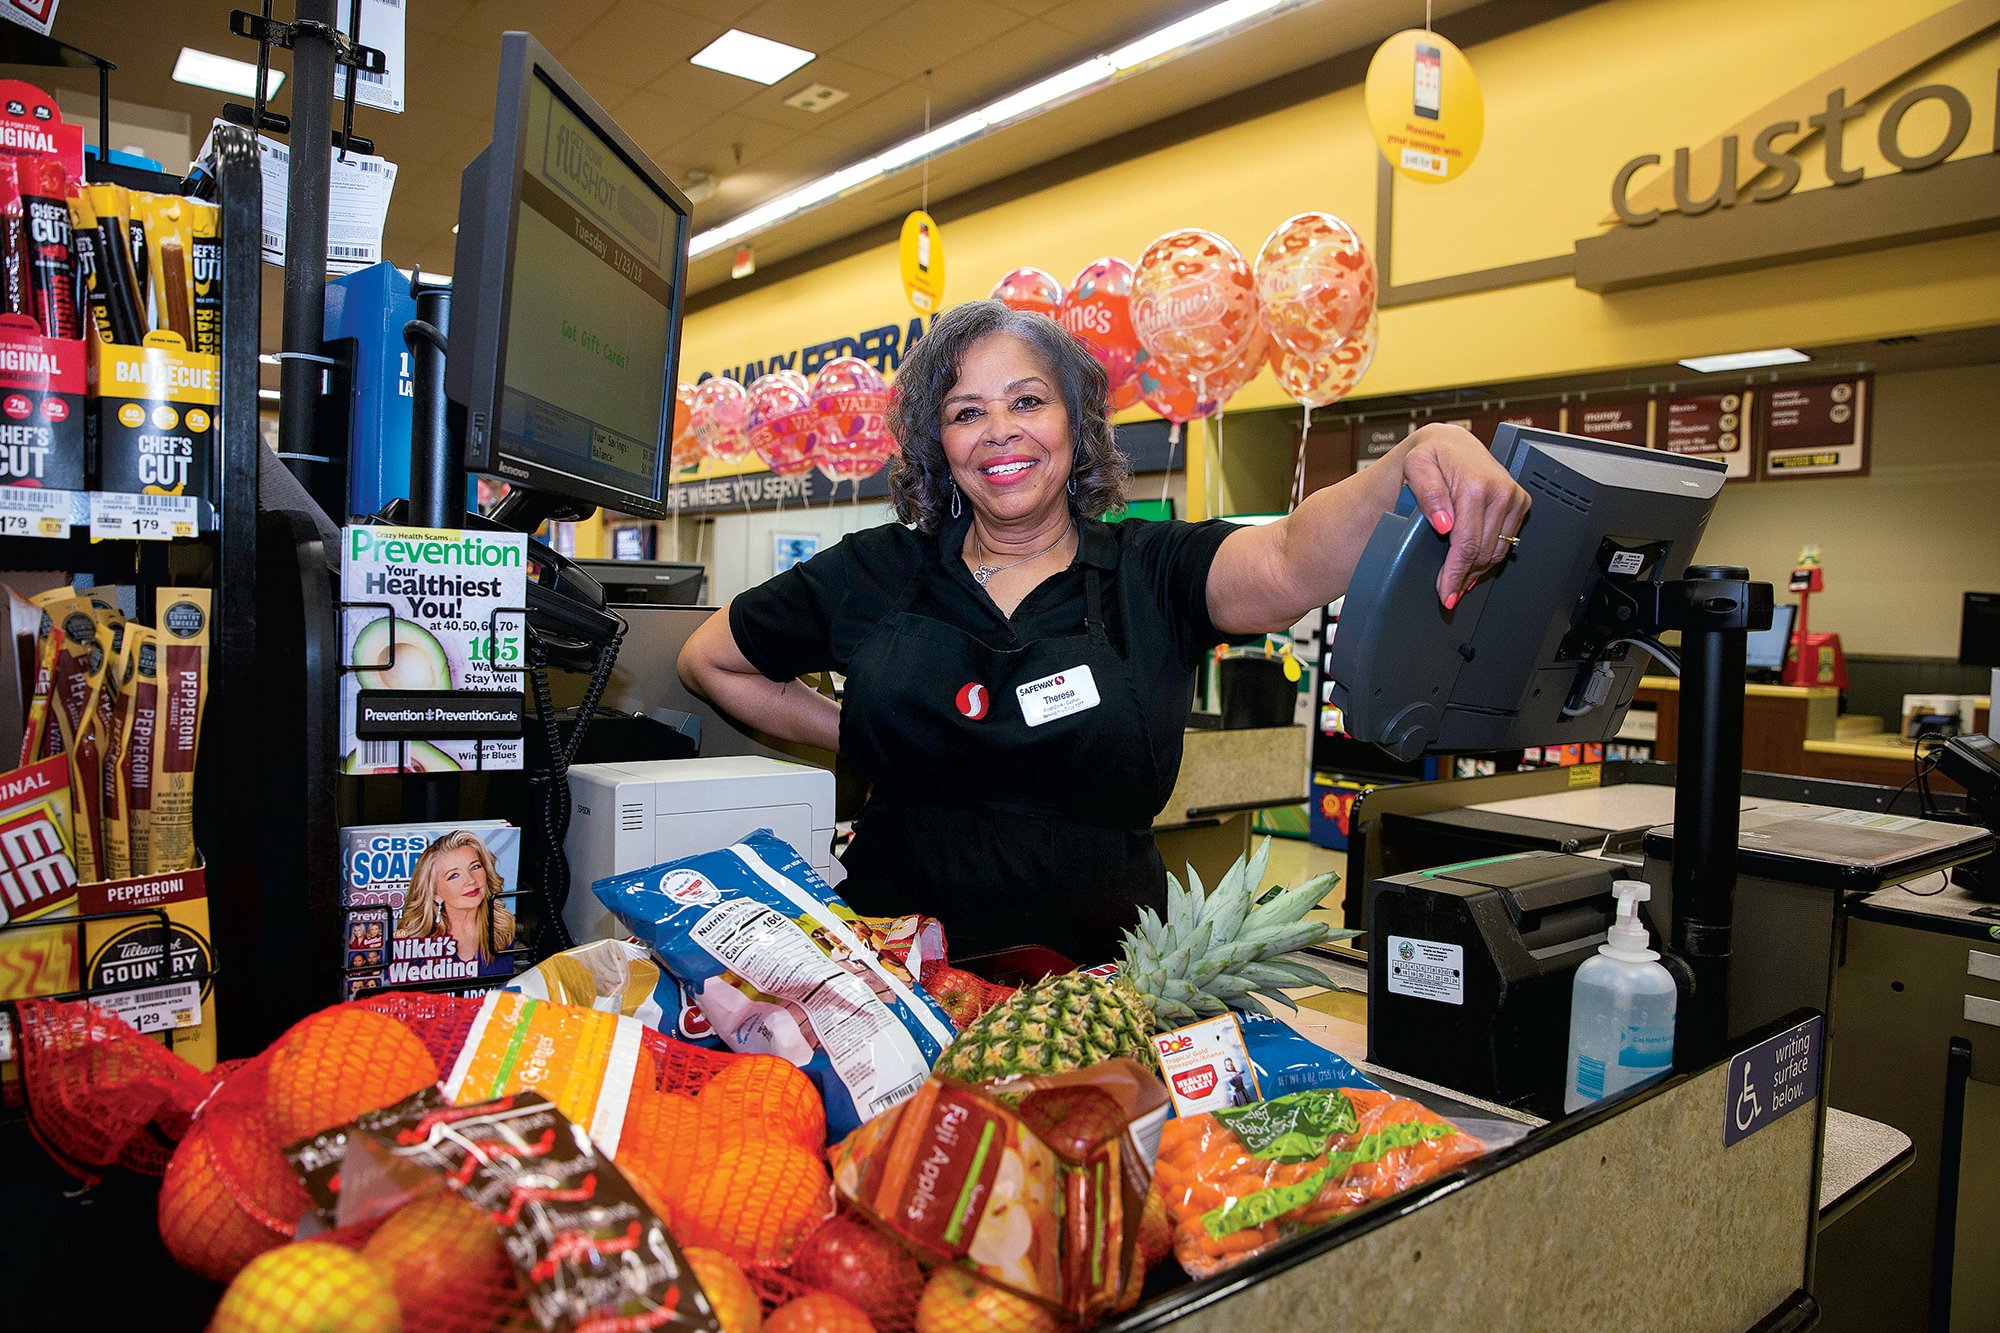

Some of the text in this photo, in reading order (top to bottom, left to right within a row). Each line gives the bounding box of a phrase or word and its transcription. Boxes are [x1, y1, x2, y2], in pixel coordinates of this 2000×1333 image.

[1612, 69, 2000, 226] custo
[574, 216, 643, 284] Tuesday 1/23/18
[561, 319, 577, 342] Got
[581, 331, 600, 354] Gift
[723, 314, 940, 387] NAVY FEDERA
[116, 361, 212, 390] BARBECUE
[400, 352, 410, 378] 1
[399, 379, 413, 398] LA
[1584, 410, 1622, 423] money
[0, 425, 50, 447] HEF'S
[138, 434, 193, 456] CHEF'S
[138, 453, 193, 486] CUT
[498, 461, 530, 480] lenovo
[687, 474, 814, 507] WHERE YOU SERVE
[375, 531, 449, 542] Crazy Health Scams
[352, 529, 521, 568] Prevention
[386, 565, 418, 577] Your
[366, 573, 502, 598] Healthiest
[407, 597, 463, 619] You!
[430, 622, 442, 631] at
[468, 636, 519, 661] 165
[465, 673, 518, 686] Stay Well
[1019, 679, 1054, 697] SAFEWAY
[1043, 688, 1076, 705] Theresa
[178, 670, 198, 751] PEPPERONI
[364, 708, 425, 722] Prevention
[435, 708, 518, 722] PreventionGuide
[131, 707, 155, 789] PEPPERONI
[458, 751, 518, 760] Winer Blues
[496, 743, 518, 752] Your
[577, 805, 591, 815] EPSON
[372, 836, 428, 852] CBS
[107, 878, 183, 902] PEPPERONI
[350, 891, 405, 910] 2018
[763, 913, 782, 928] 160
[117, 938, 182, 960] Tillamok
[391, 936, 457, 960] Nikki's
[102, 953, 198, 985] COUNRY
[389, 960, 479, 983] Wedding
[1158, 1035, 1192, 1054] Dole
[1192, 1048, 1208, 1057] Gold
[1774, 1034, 1811, 1064] writing
[1176, 1071, 1213, 1089] HEALTHY
[1773, 1056, 1808, 1088] surface
[1771, 1082, 1804, 1112] below.
[907, 1103, 969, 1223] Fuji Apples
